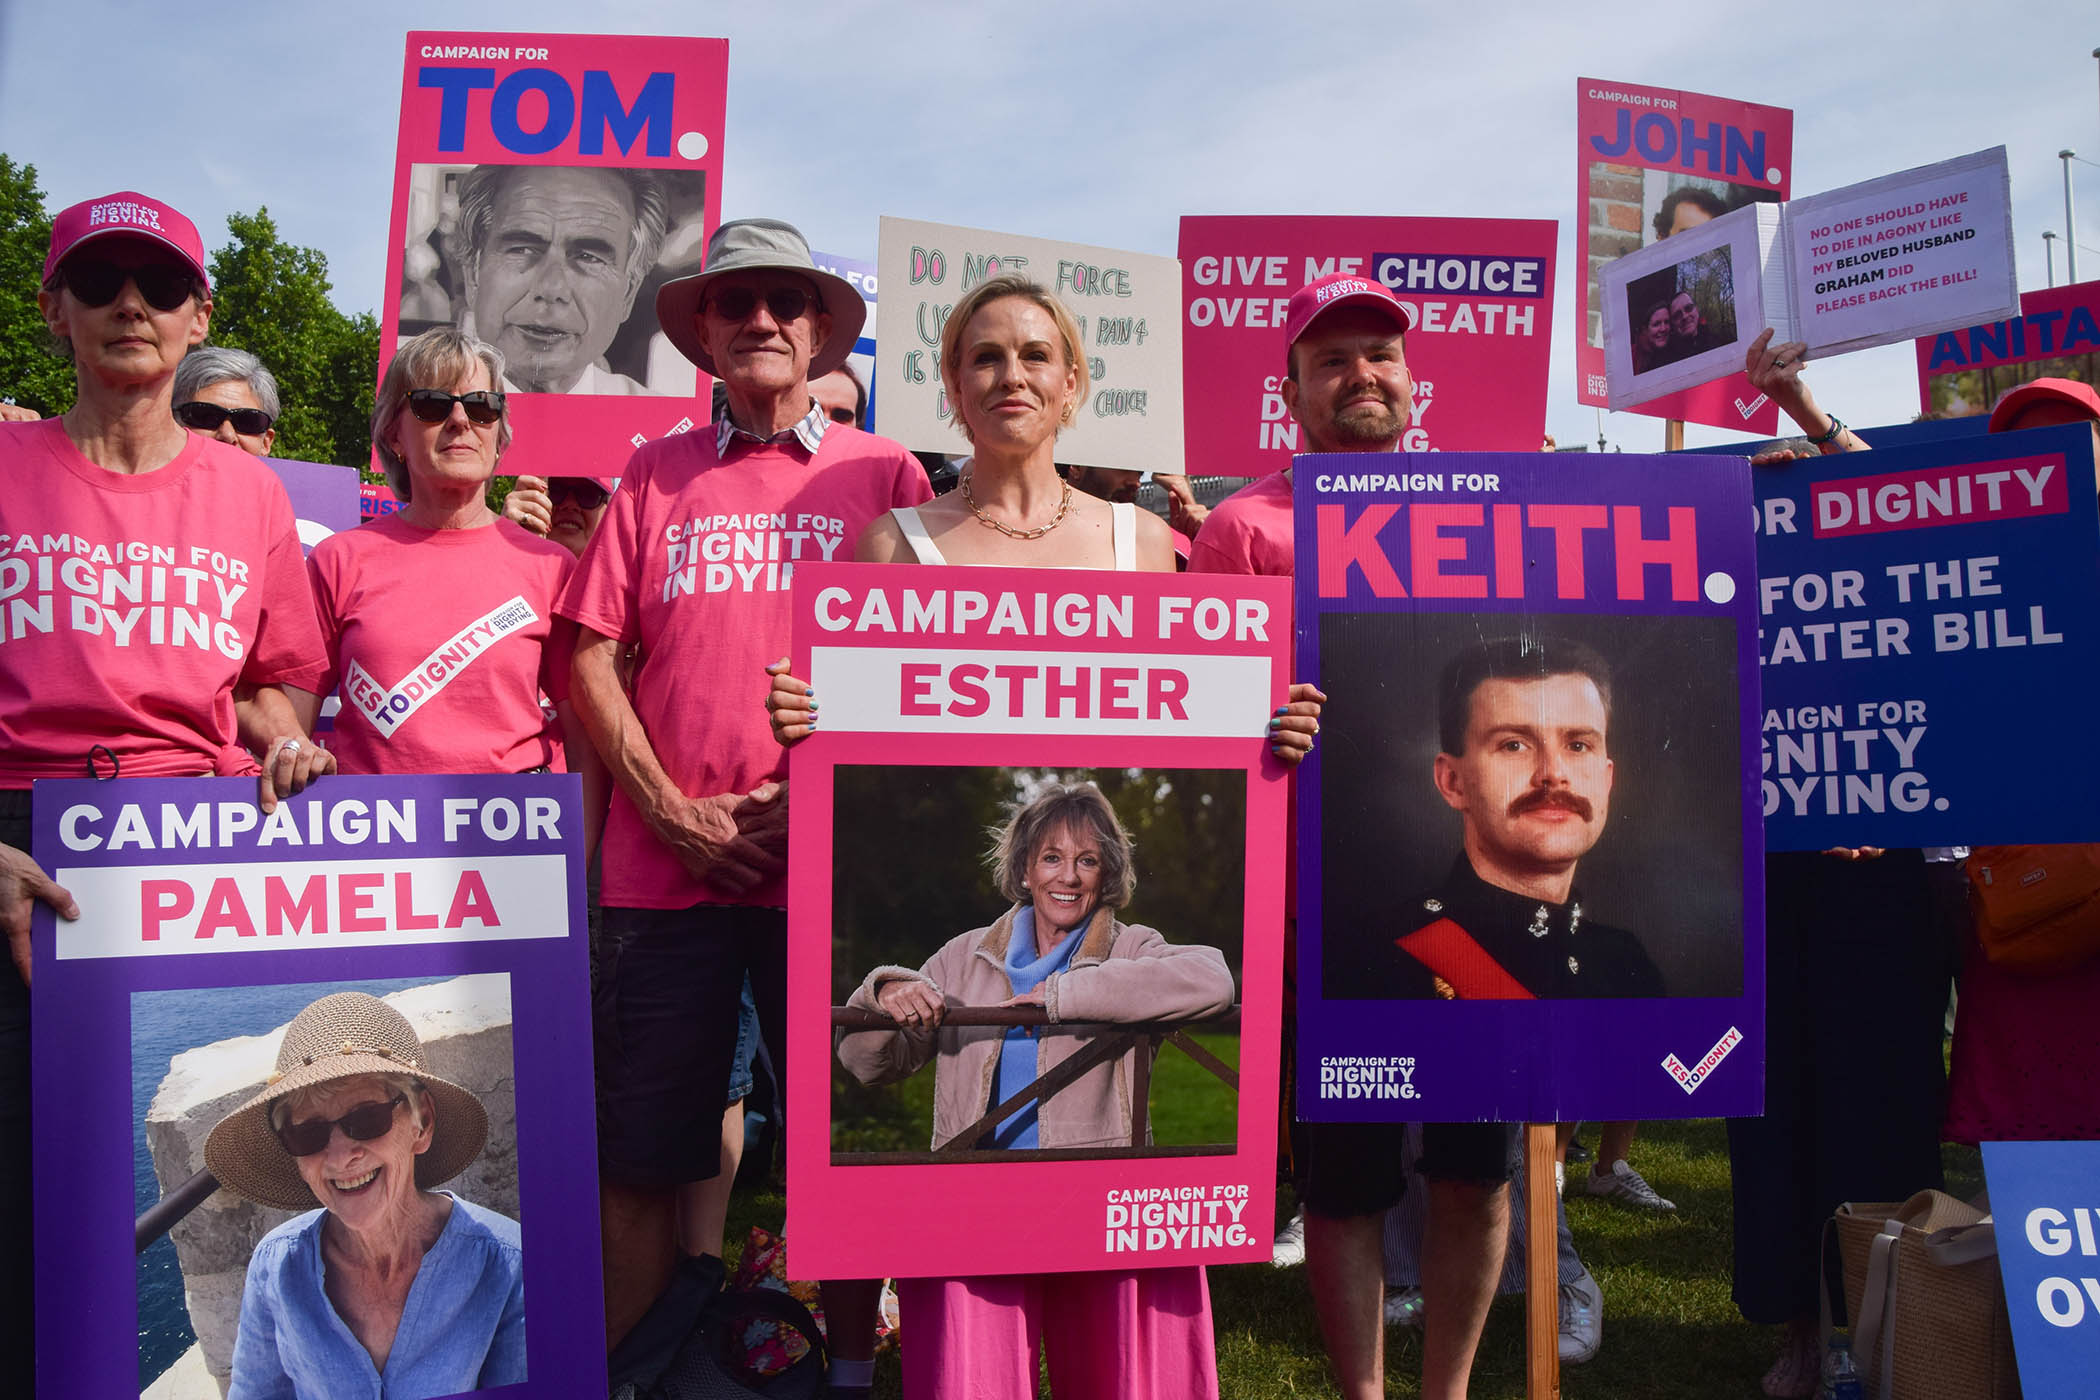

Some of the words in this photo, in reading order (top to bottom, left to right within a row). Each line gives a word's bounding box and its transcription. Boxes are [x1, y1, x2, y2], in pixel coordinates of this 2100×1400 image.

[420, 45, 510, 60] CAMPAIGN
[514, 47, 549, 61] FOR
[418, 66, 709, 160] TOM.
[1588, 88, 1650, 107] CAMPAIGN
[1653, 98, 1677, 110] FOR
[1590, 108, 1782, 185] JOHN.
[90, 216, 106, 226] IN
[91, 201, 139, 210] CAMPAIGN
[91, 206, 159, 222] DIGNITY
[1810, 226, 1831, 241] NO
[1833, 218, 1863, 234] ONE
[1865, 203, 1926, 226] SHOULD
[1928, 192, 1969, 211] HAVE
[1811, 244, 1829, 257] TO
[1832, 238, 1855, 254] DIE
[1857, 234, 1873, 248] IN
[1875, 221, 1927, 243] AGONY
[1930, 212, 1963, 229] LIKE
[1813, 262, 1832, 275] MY
[1836, 246, 1899, 270] BELOVED
[1902, 228, 1976, 254] HUSBAND
[910, 245, 947, 286] DO
[1056, 260, 1132, 297] FORCE
[1193, 256, 1289, 287] GIVE
[1304, 257, 1364, 287] ME
[1377, 257, 1539, 293] CHOICE
[1815, 268, 1885, 295] GRAHAM
[1887, 264, 1914, 279] DID
[1815, 293, 1866, 314] PLEASE
[1869, 284, 1908, 302] BACK
[1910, 277, 1938, 293] THE
[1941, 269, 1978, 286] BILL!
[1189, 297, 1289, 328] OVER
[1094, 388, 1148, 419] CHOICE!
[1259, 423, 1299, 451] IN
[1315, 474, 1444, 493] CAMPAIGN
[1452, 473, 1500, 492] FOR
[1817, 464, 2056, 531] DIGNITY
[666, 513, 786, 543] CAMPAIGN
[796, 513, 845, 535] FOR
[191, 546, 249, 582] FOR
[666, 531, 845, 575] DIGNITY
[1316, 503, 1736, 604] KEITH.
[0, 556, 248, 621] DIGNITY
[663, 563, 698, 604] IN
[1760, 569, 1866, 615] FOR
[1886, 555, 2002, 603] THE
[71, 594, 244, 661] DYING
[493, 605, 526, 627] DIGNITY
[814, 586, 1134, 638] CAMPAIGN
[1157, 596, 1270, 642] FOR
[1759, 617, 1912, 667] ATER
[1933, 605, 2064, 653] BILL
[349, 666, 383, 713] YES
[375, 693, 410, 726] TO
[402, 621, 496, 702] DIGNITY
[899, 662, 1190, 721] ESTHER
[1761, 704, 1844, 732] AIGN
[1858, 699, 1928, 726] FOR
[58, 799, 417, 852] CAMPAIGN
[443, 797, 563, 843] FOR
[140, 869, 501, 942] PAMELA
[1321, 1056, 1387, 1066] CAMPAIGN
[1390, 1056, 1416, 1066] FOR
[1321, 1066, 1416, 1083] DIGNITY
[1667, 1057, 1688, 1081] YES
[1684, 1073, 1700, 1089] TO
[1696, 1030, 1738, 1077] DIGNITY
[1321, 1083, 1343, 1099] IN
[1347, 1083, 1422, 1099] DYING.
[1106, 1199, 1249, 1228] DIGNITY
[1107, 1186, 1206, 1203] CAMPAIGN
[1212, 1184, 1249, 1199] FOR
[1106, 1228, 1139, 1253] IN
[1146, 1223, 1257, 1251] DYING.
[2025, 1207, 2100, 1257] GI
